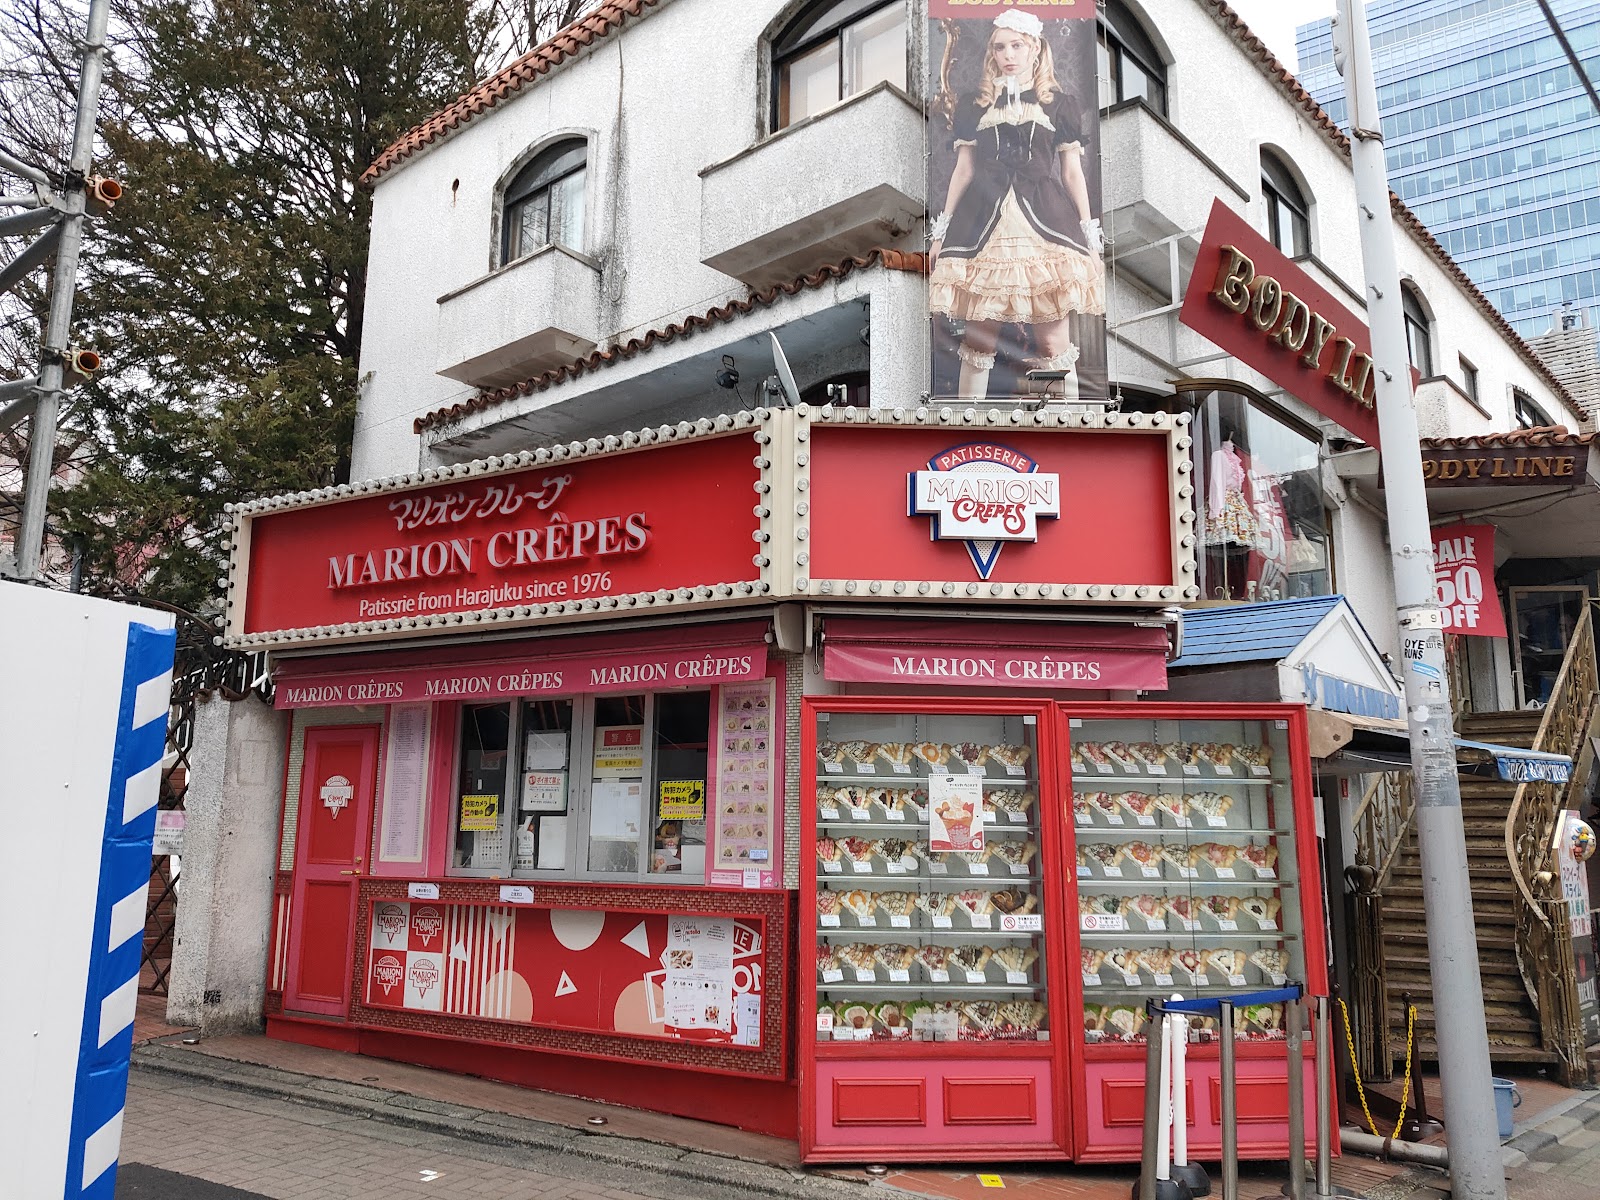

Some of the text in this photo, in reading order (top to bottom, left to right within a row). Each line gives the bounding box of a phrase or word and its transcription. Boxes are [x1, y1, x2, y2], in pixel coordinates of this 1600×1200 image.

[1209, 245, 1337, 369] BODY
[940, 446, 1027, 470] PATISSERIE
[1422, 456, 1576, 480] ODY LINE
[388, 473, 573, 531] マリオンクレープ
[927, 478, 1053, 504] MARION
[328, 512, 648, 589] MARION CRÊPES
[359, 571, 612, 617] Patissrie from Harajuku since 1976
[1405, 649, 1423, 660] RUNS
[590, 655, 751, 686] MARION CRÊPES
[891, 655, 1101, 681] MARION CRÊPES
[285, 679, 404, 703] MARION CRÊPES
[425, 669, 563, 696] MARION CRÊPES
[414, 918, 440, 928] MARION
[376, 967, 401, 978] MARION
[412, 969, 437, 979] MARION
